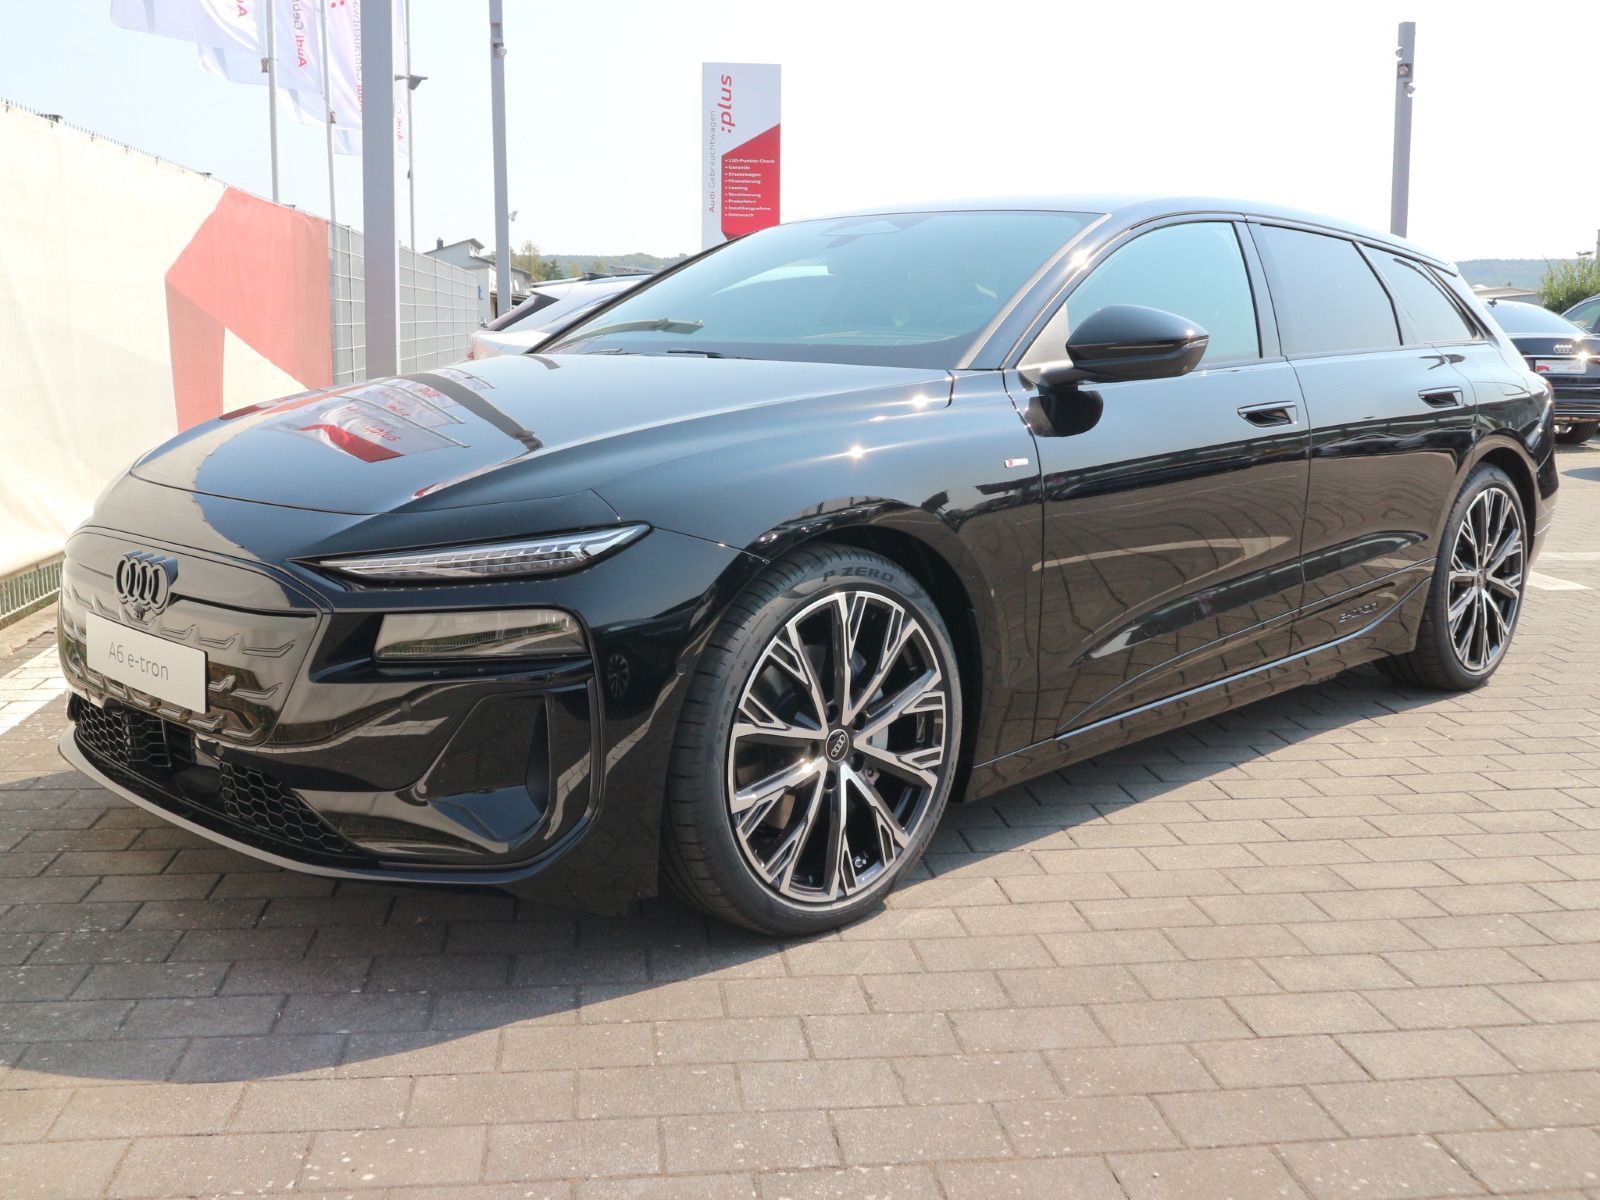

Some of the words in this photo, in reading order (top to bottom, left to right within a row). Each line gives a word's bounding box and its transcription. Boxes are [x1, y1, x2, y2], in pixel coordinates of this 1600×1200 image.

[717, 75, 735, 134] :plus
[709, 110, 718, 188] Gebrauchtwagen
[708, 192, 716, 213] Audi
[823, 570, 836, 582] P
[841, 566, 894, 582] ZERO
[108, 641, 124, 663] A6
[127, 653, 169, 681] e-tron
